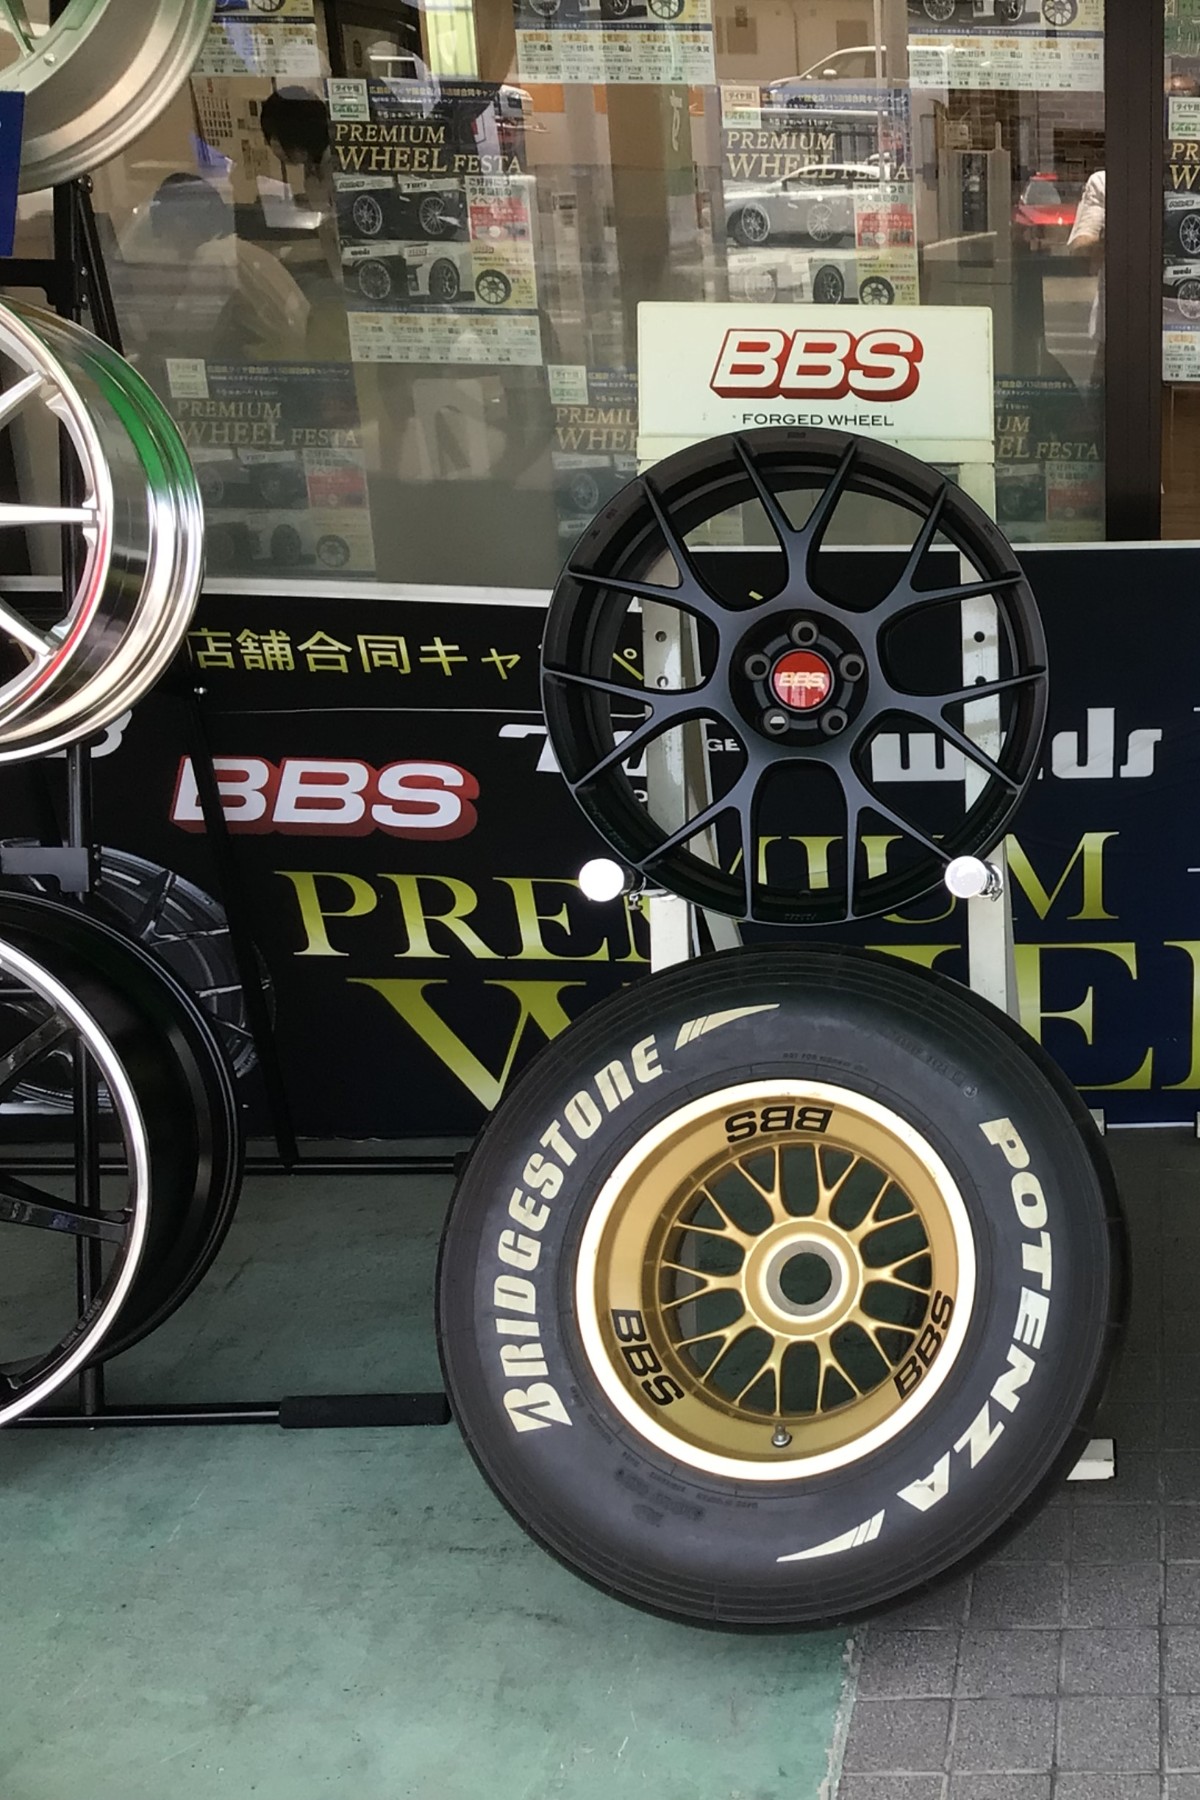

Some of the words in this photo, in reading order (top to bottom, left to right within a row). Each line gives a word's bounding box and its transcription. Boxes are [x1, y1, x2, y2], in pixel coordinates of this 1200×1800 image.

[335, 124, 446, 144] PREMIUM
[726, 132, 836, 150] PREMIUM
[335, 145, 448, 172] WHEEL
[452, 154, 522, 173] FESTA
[726, 153, 837, 179] WHEEL
[709, 328, 924, 402] BBS
[177, 401, 282, 418] PREMIUM
[555, 406, 639, 425] PREMIU
[742, 413, 824, 426] FORGED
[828, 414, 895, 427] WHEEL
[178, 421, 285, 446] WHEEL
[291, 428, 359, 447] FESTA
[778, 671, 826, 690] BBS
[870, 707, 1163, 783] wds
[170, 754, 480, 841] BBS
[723, 1105, 834, 1144] BBS
[494, 1034, 663, 1433] BRIDGESTONE
[896, 1117, 1053, 1512] POTENZA
[611, 1308, 685, 1408] BBS
[895, 1290, 954, 1401] BBS
